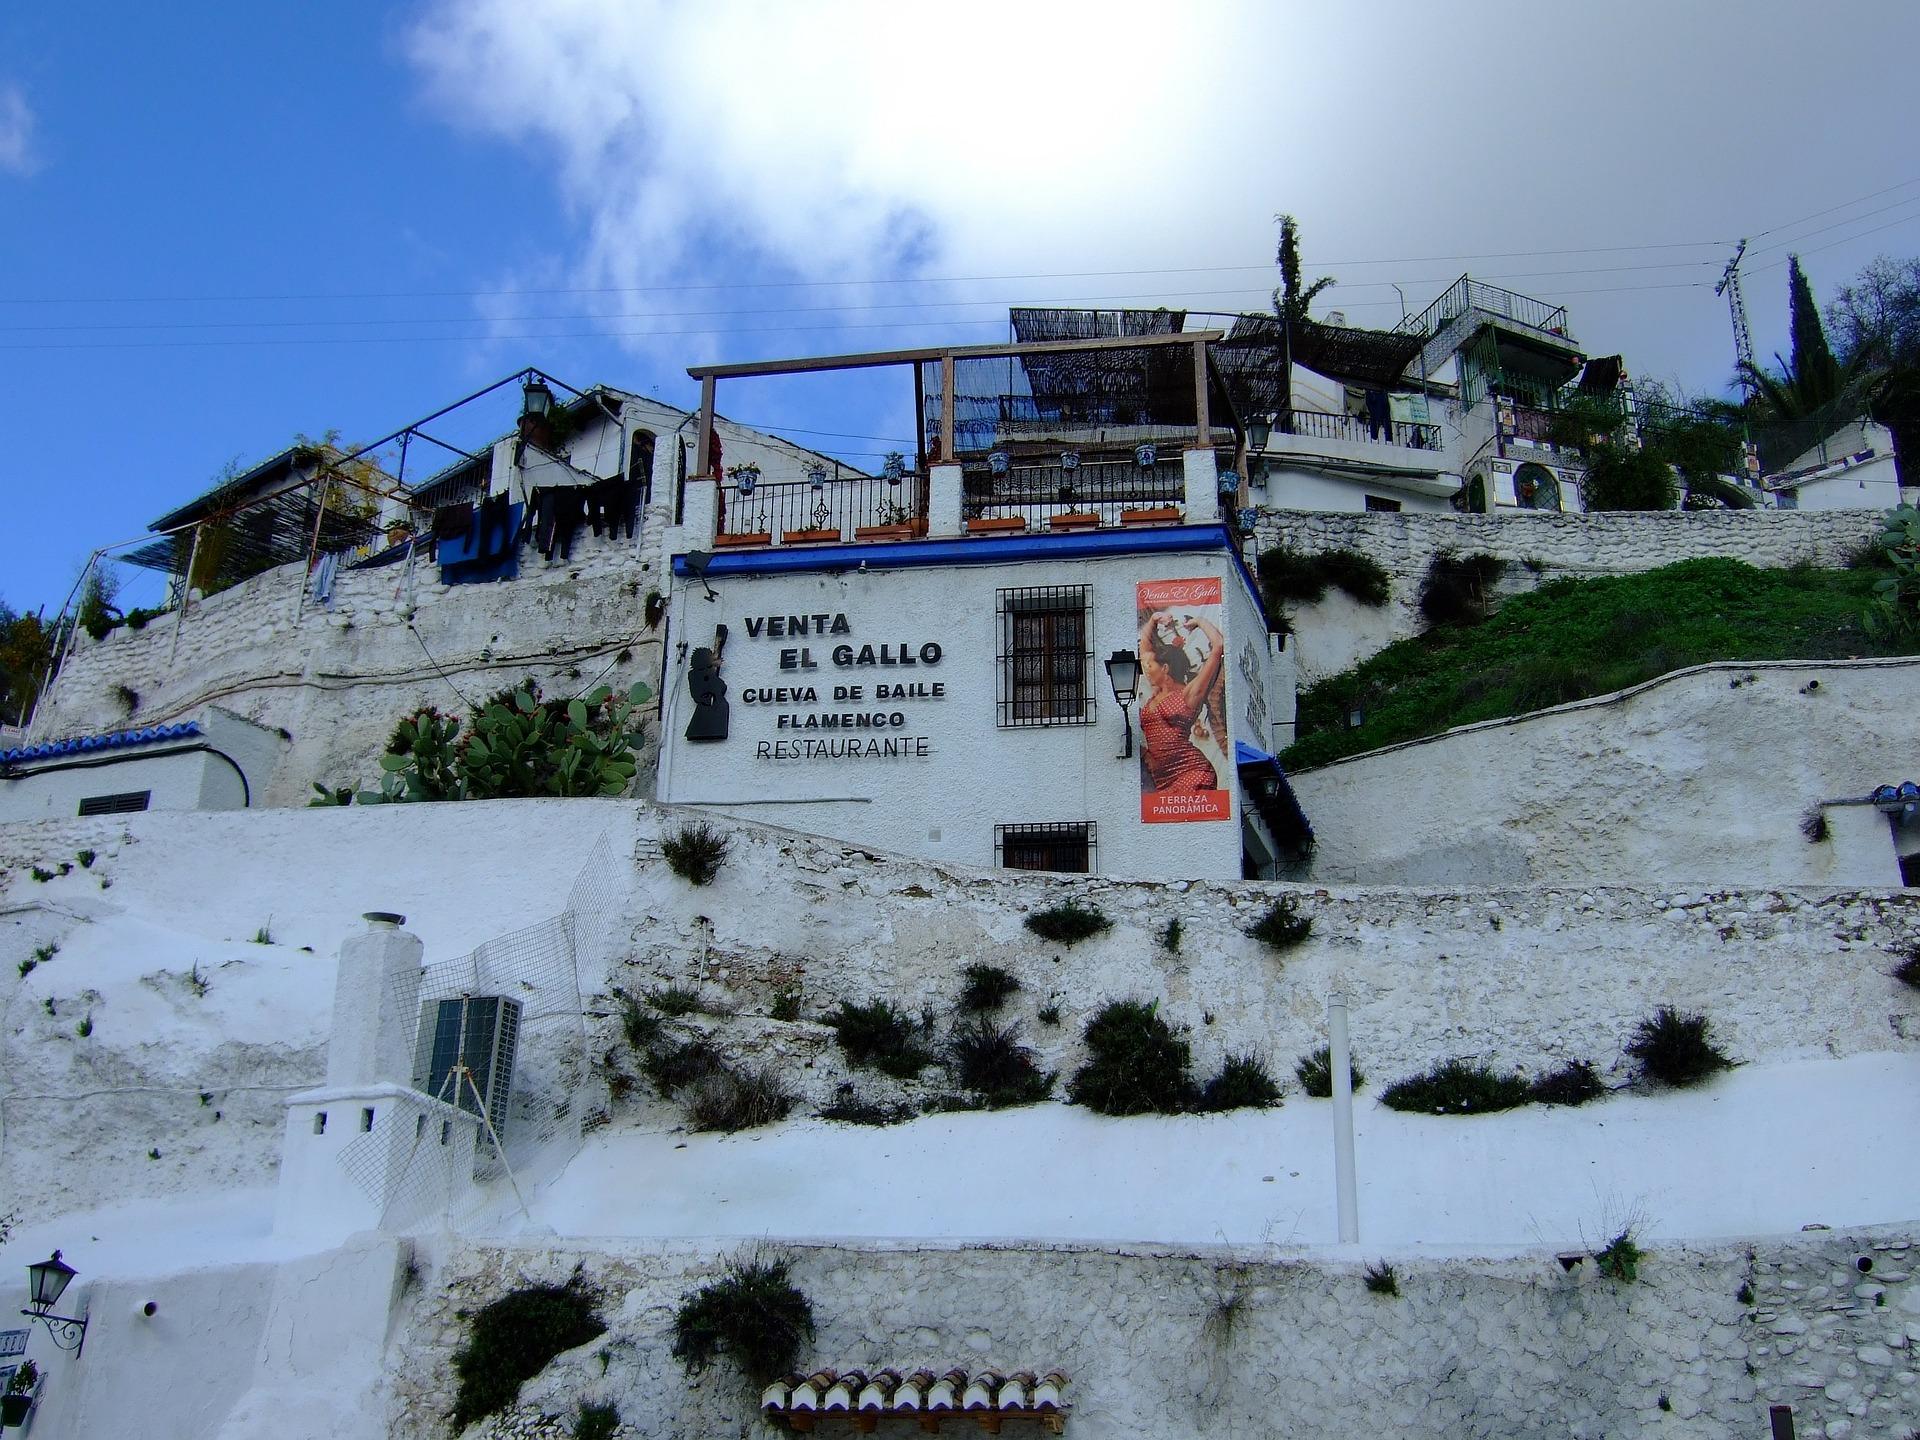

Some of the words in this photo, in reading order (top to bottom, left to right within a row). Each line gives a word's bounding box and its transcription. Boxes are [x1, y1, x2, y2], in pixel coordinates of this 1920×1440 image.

[1139, 586, 1169, 600] Venta
[1170, 586, 1189, 599] El
[1190, 584, 1218, 600] Gallo
[745, 613, 851, 638] VENTA
[780, 648, 818, 669] EL
[832, 642, 942, 666] GALLO
[742, 687, 818, 704] CUEVA
[833, 686, 863, 700] DE
[876, 683, 945, 698] BAILE
[777, 712, 905, 729] FLAMENCO
[756, 736, 929, 760] RESTAURANTE
[1153, 803, 1219, 814] PANORÁMICA
[1160, 795, 1208, 805] TERRAZA
